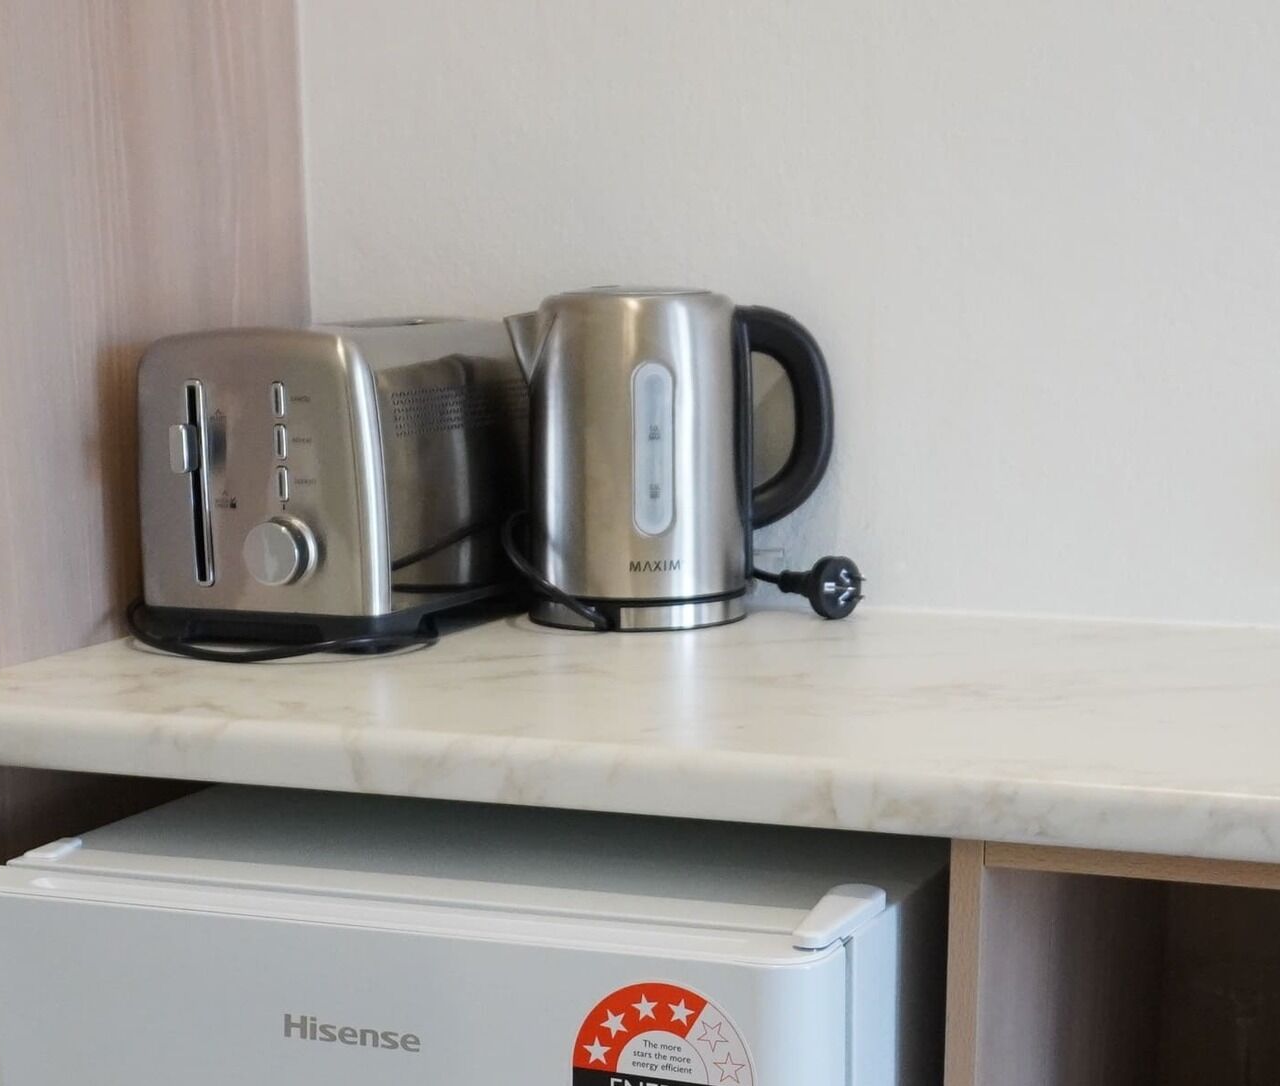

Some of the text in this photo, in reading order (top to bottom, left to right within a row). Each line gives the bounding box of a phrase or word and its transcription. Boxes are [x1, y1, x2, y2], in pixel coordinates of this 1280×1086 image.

[629, 559, 681, 572] MAXIM
[283, 1013, 421, 1053] Hisense
[642, 1039, 682, 1052] The more
[633, 1049, 692, 1064] stars the more
[631, 1060, 693, 1075] energy efficient
